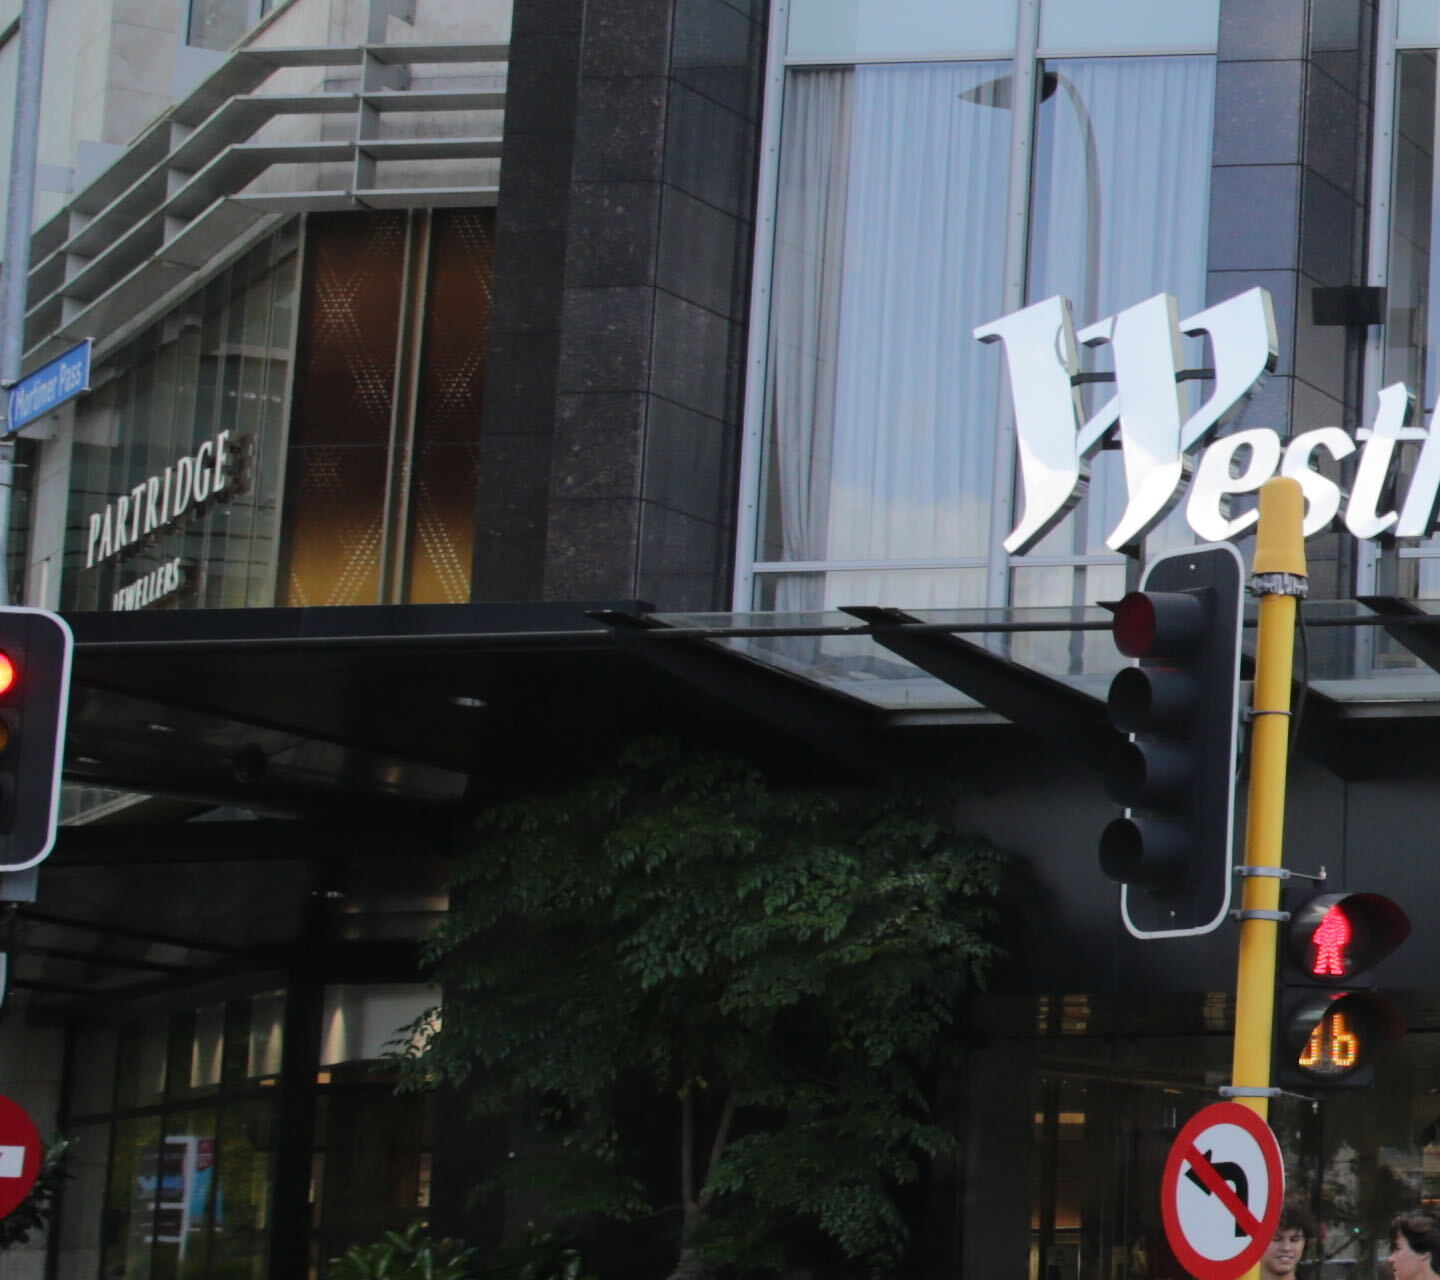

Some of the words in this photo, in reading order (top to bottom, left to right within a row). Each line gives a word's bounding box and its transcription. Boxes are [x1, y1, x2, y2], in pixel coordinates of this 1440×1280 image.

[15, 376, 58, 422] Mortimer
[60, 362, 82, 396] Pass
[86, 429, 230, 569] PARTRIDGE
[113, 557, 181, 612] JEWELLERS
